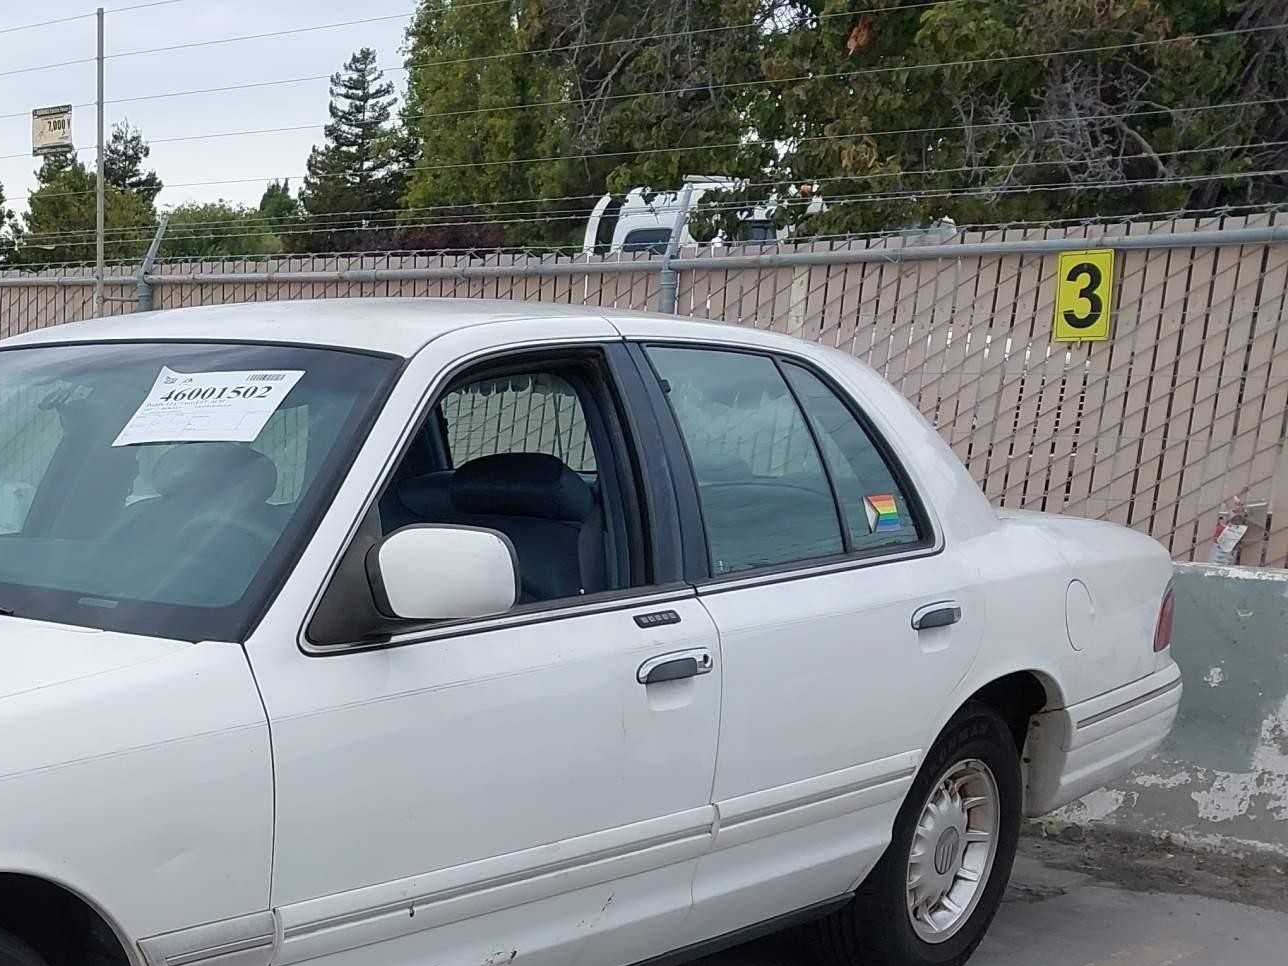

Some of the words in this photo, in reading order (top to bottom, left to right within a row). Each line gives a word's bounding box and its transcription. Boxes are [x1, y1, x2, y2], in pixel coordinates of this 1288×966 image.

[48, 119, 65, 132] 7,000
[1063, 262, 1103, 329] 3
[160, 385, 273, 402] 46001502
